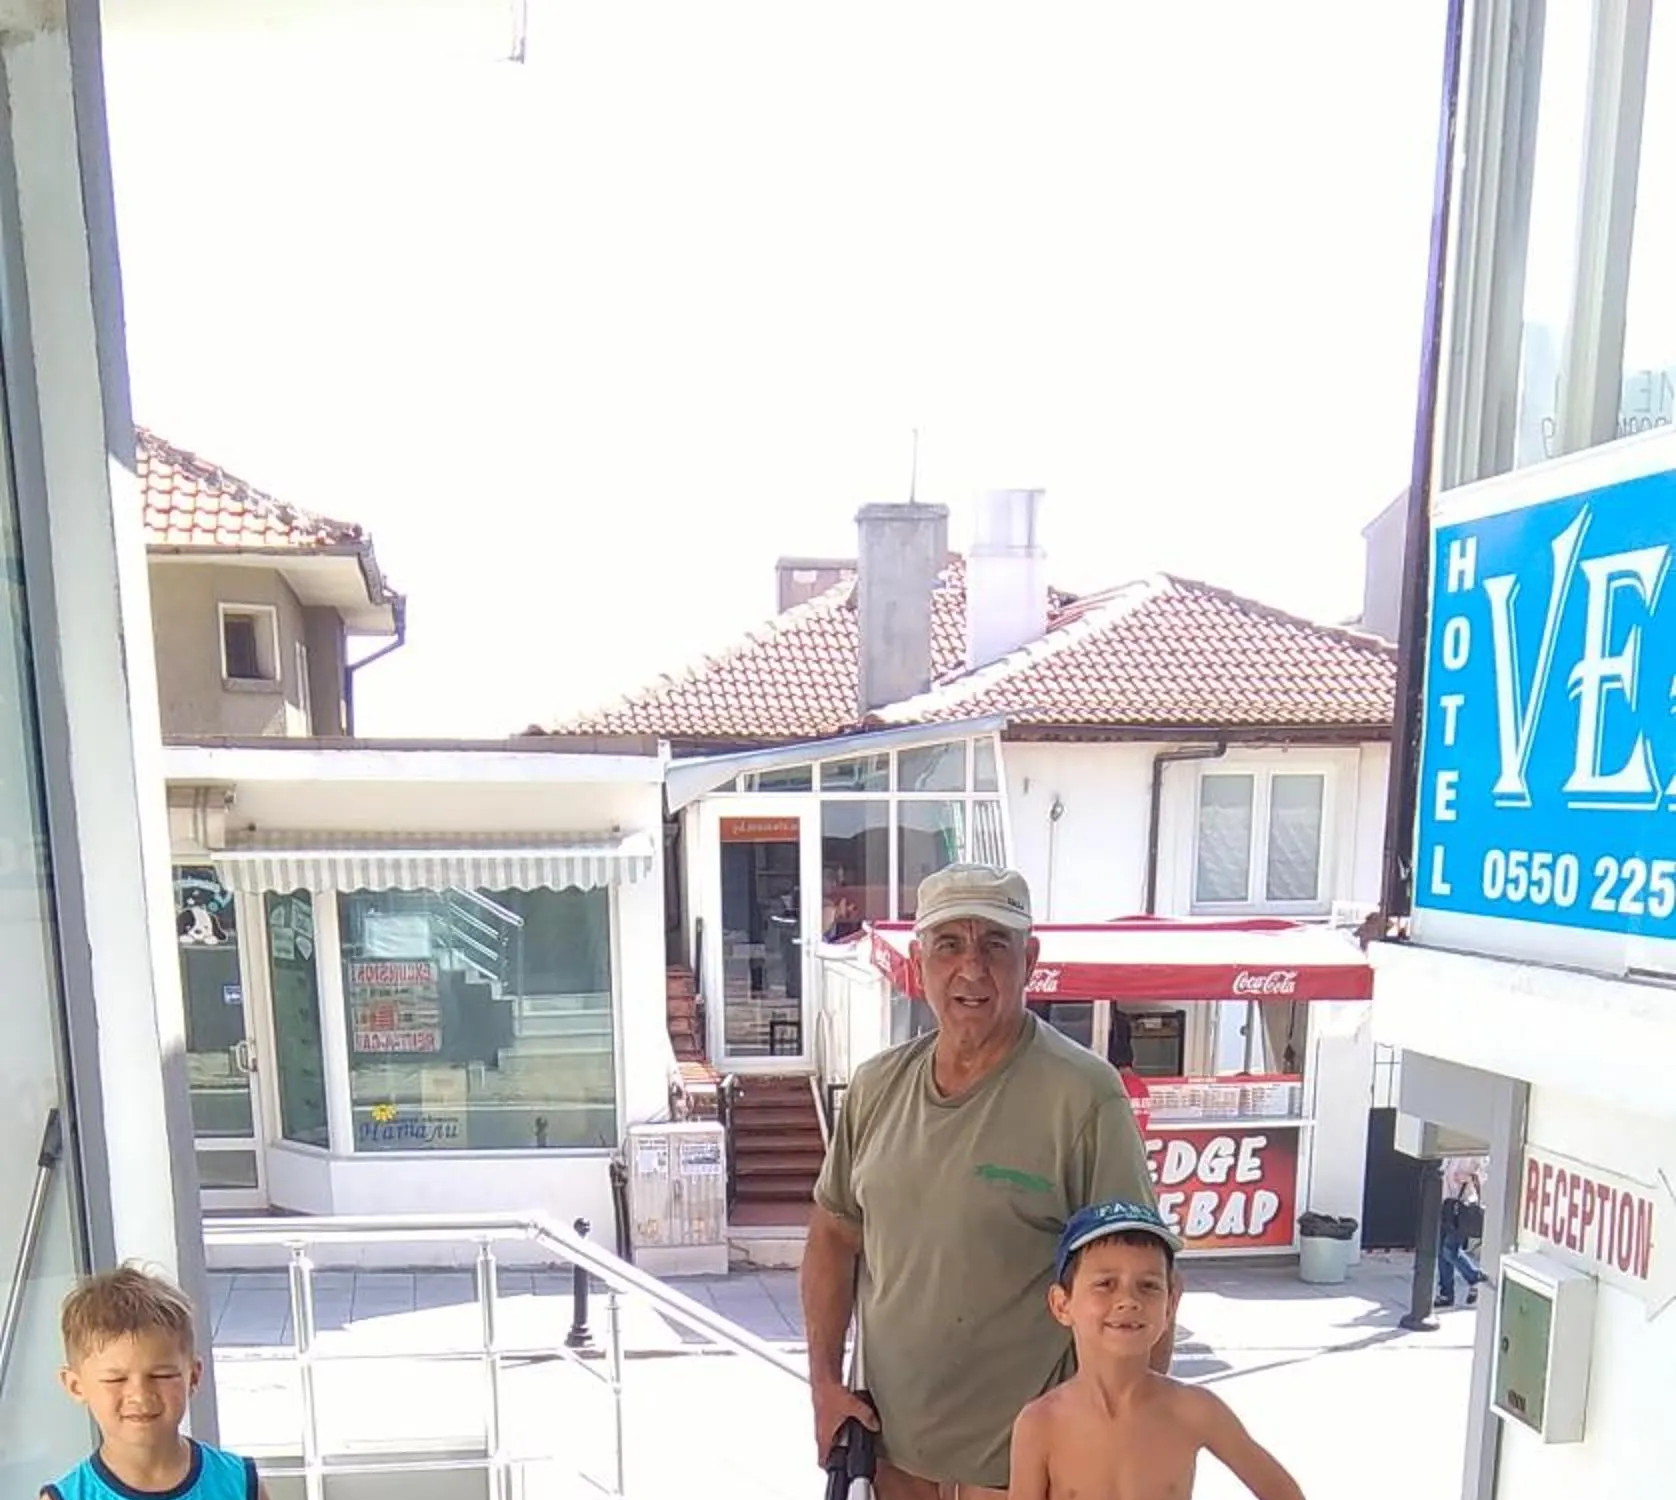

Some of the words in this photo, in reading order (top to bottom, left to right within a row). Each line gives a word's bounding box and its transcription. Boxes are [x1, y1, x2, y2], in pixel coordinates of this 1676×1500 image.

[1430, 536, 1477, 895] HOTEL
[1482, 502, 1676, 812] VE
[1482, 849, 1579, 907] 0550
[1158, 1190, 1279, 1237] EBAP
[1523, 1157, 1653, 1280] RECEPTION
